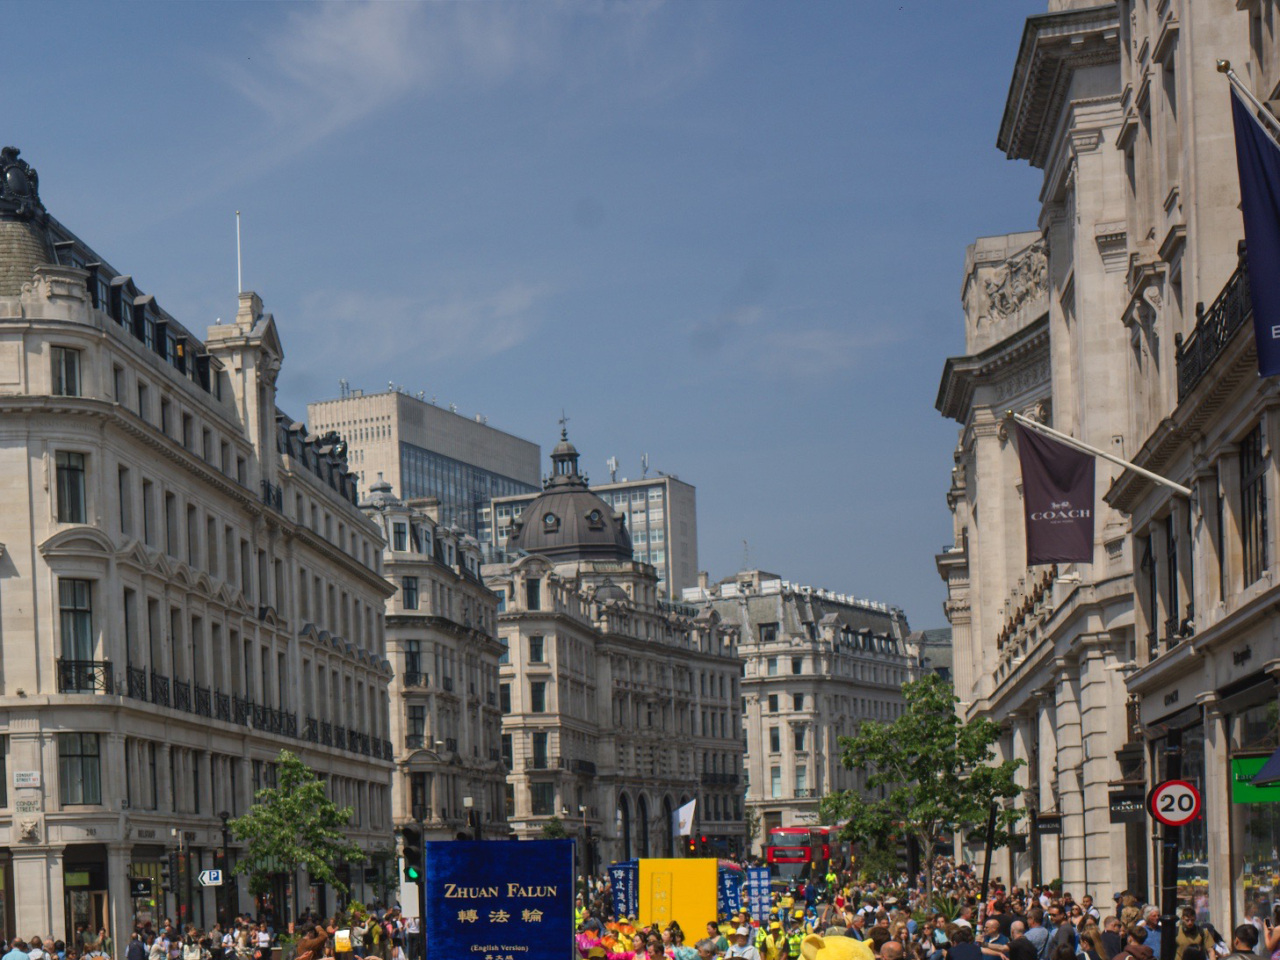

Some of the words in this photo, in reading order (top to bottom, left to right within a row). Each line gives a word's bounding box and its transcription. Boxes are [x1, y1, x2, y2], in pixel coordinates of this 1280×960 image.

[1031, 510, 1090, 520] COACH
[1160, 794, 1194, 812] 20
[457, 909, 543, 923] 轉法輪
